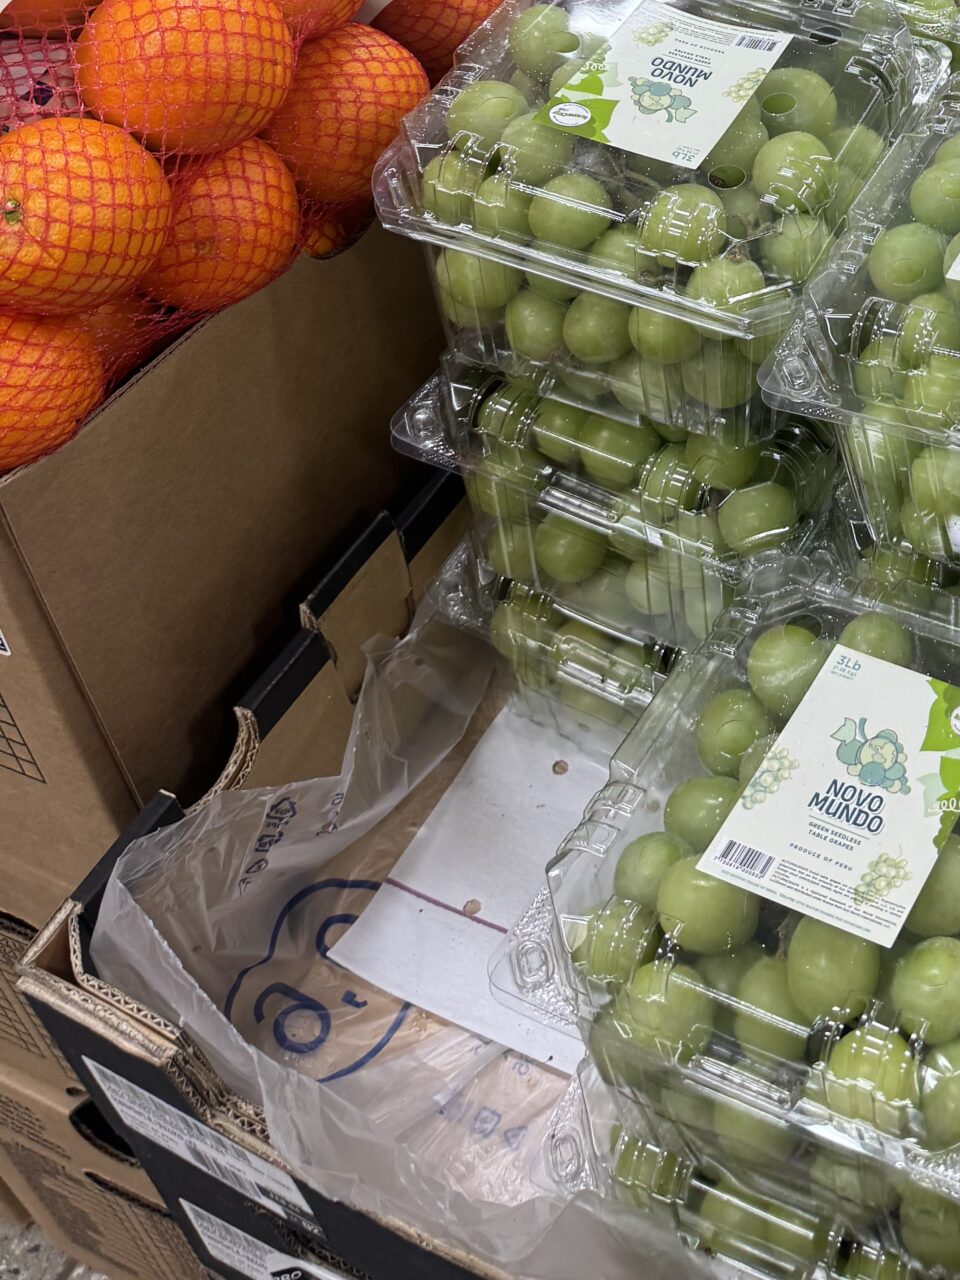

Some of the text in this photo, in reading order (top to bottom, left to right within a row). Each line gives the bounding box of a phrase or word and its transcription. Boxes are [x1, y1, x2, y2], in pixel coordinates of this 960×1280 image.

[650, 68, 700, 89] NOVO
[651, 56, 713, 82] MUNDO
[837, 655, 862, 671] 3Lb
[826, 778, 884, 814] NOVO
[808, 791, 884, 835] MUNDO
[808, 821, 862, 846] GREEN SEEDLESS
[808, 829, 854, 851] TABLE GRAPES
[789, 842, 853, 871] PRODUCE OF PERU
